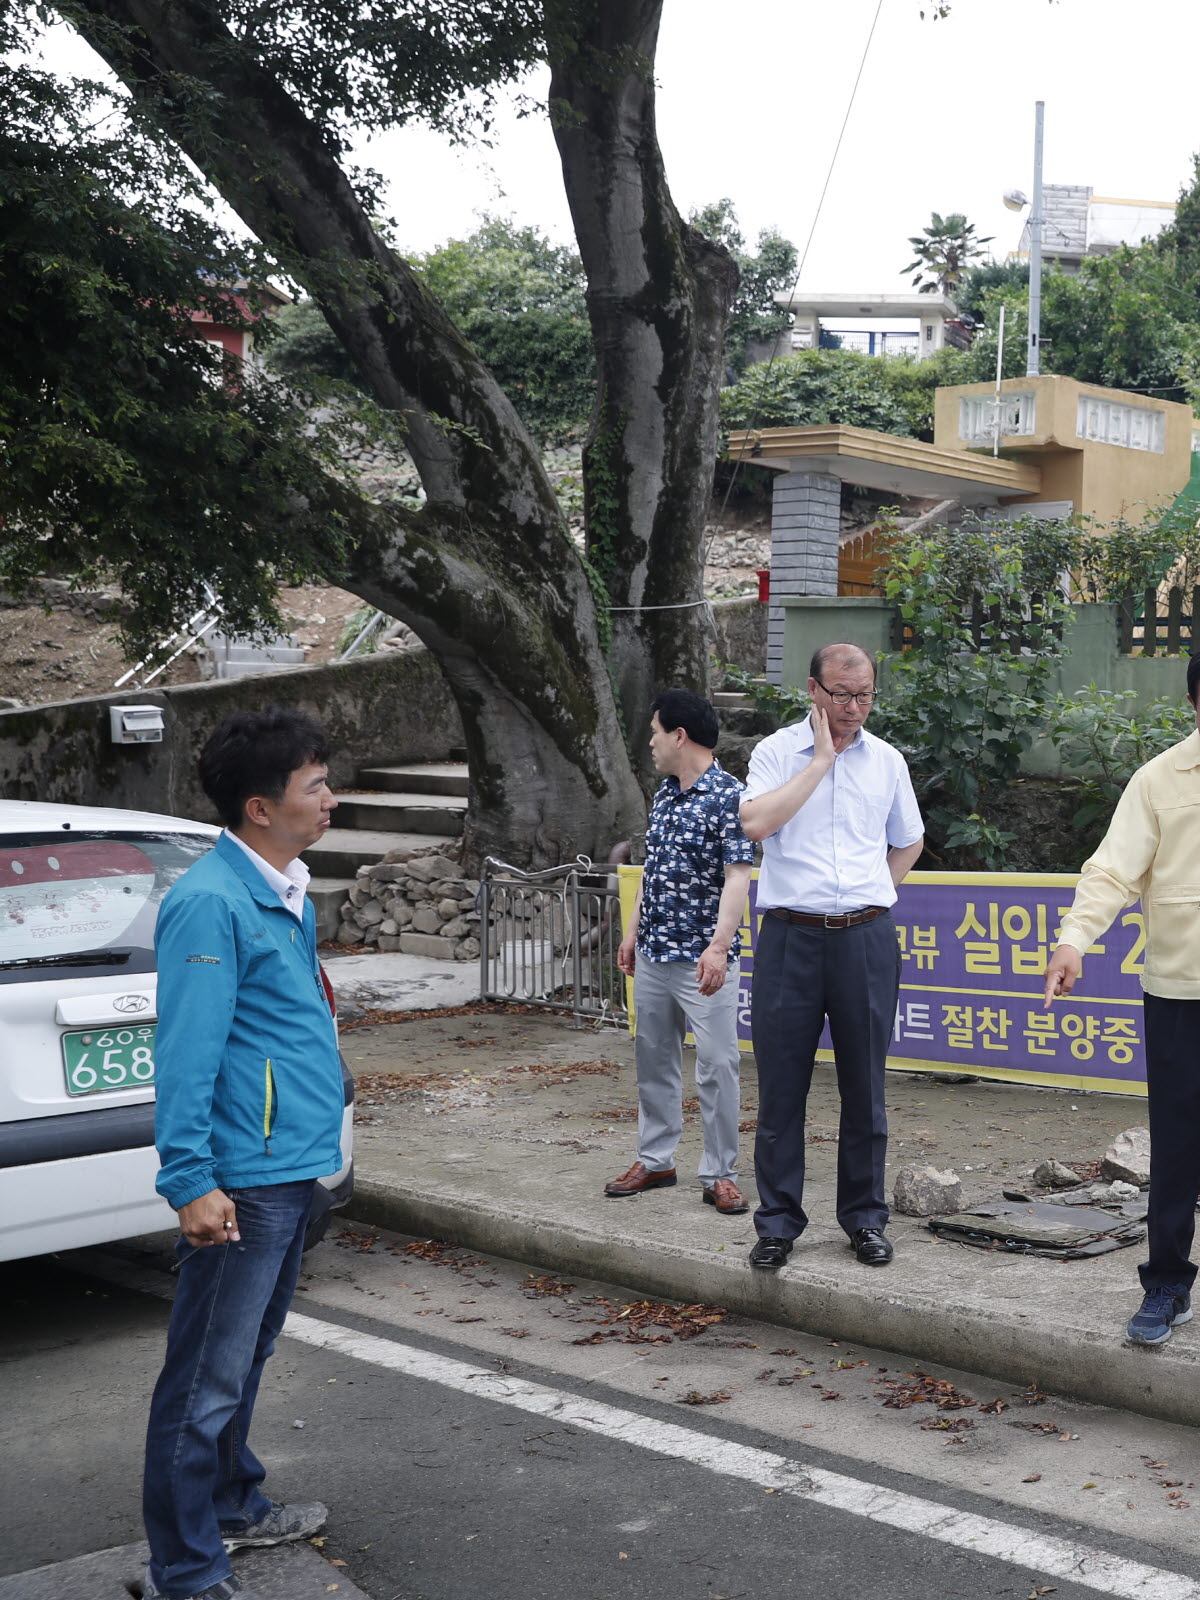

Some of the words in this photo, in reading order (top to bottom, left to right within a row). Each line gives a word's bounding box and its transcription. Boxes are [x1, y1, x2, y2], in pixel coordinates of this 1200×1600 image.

[96, 1028, 154, 1047] 60우
[941, 1004, 1013, 1051] 절찬
[1023, 1011, 1141, 1064] 분양중
